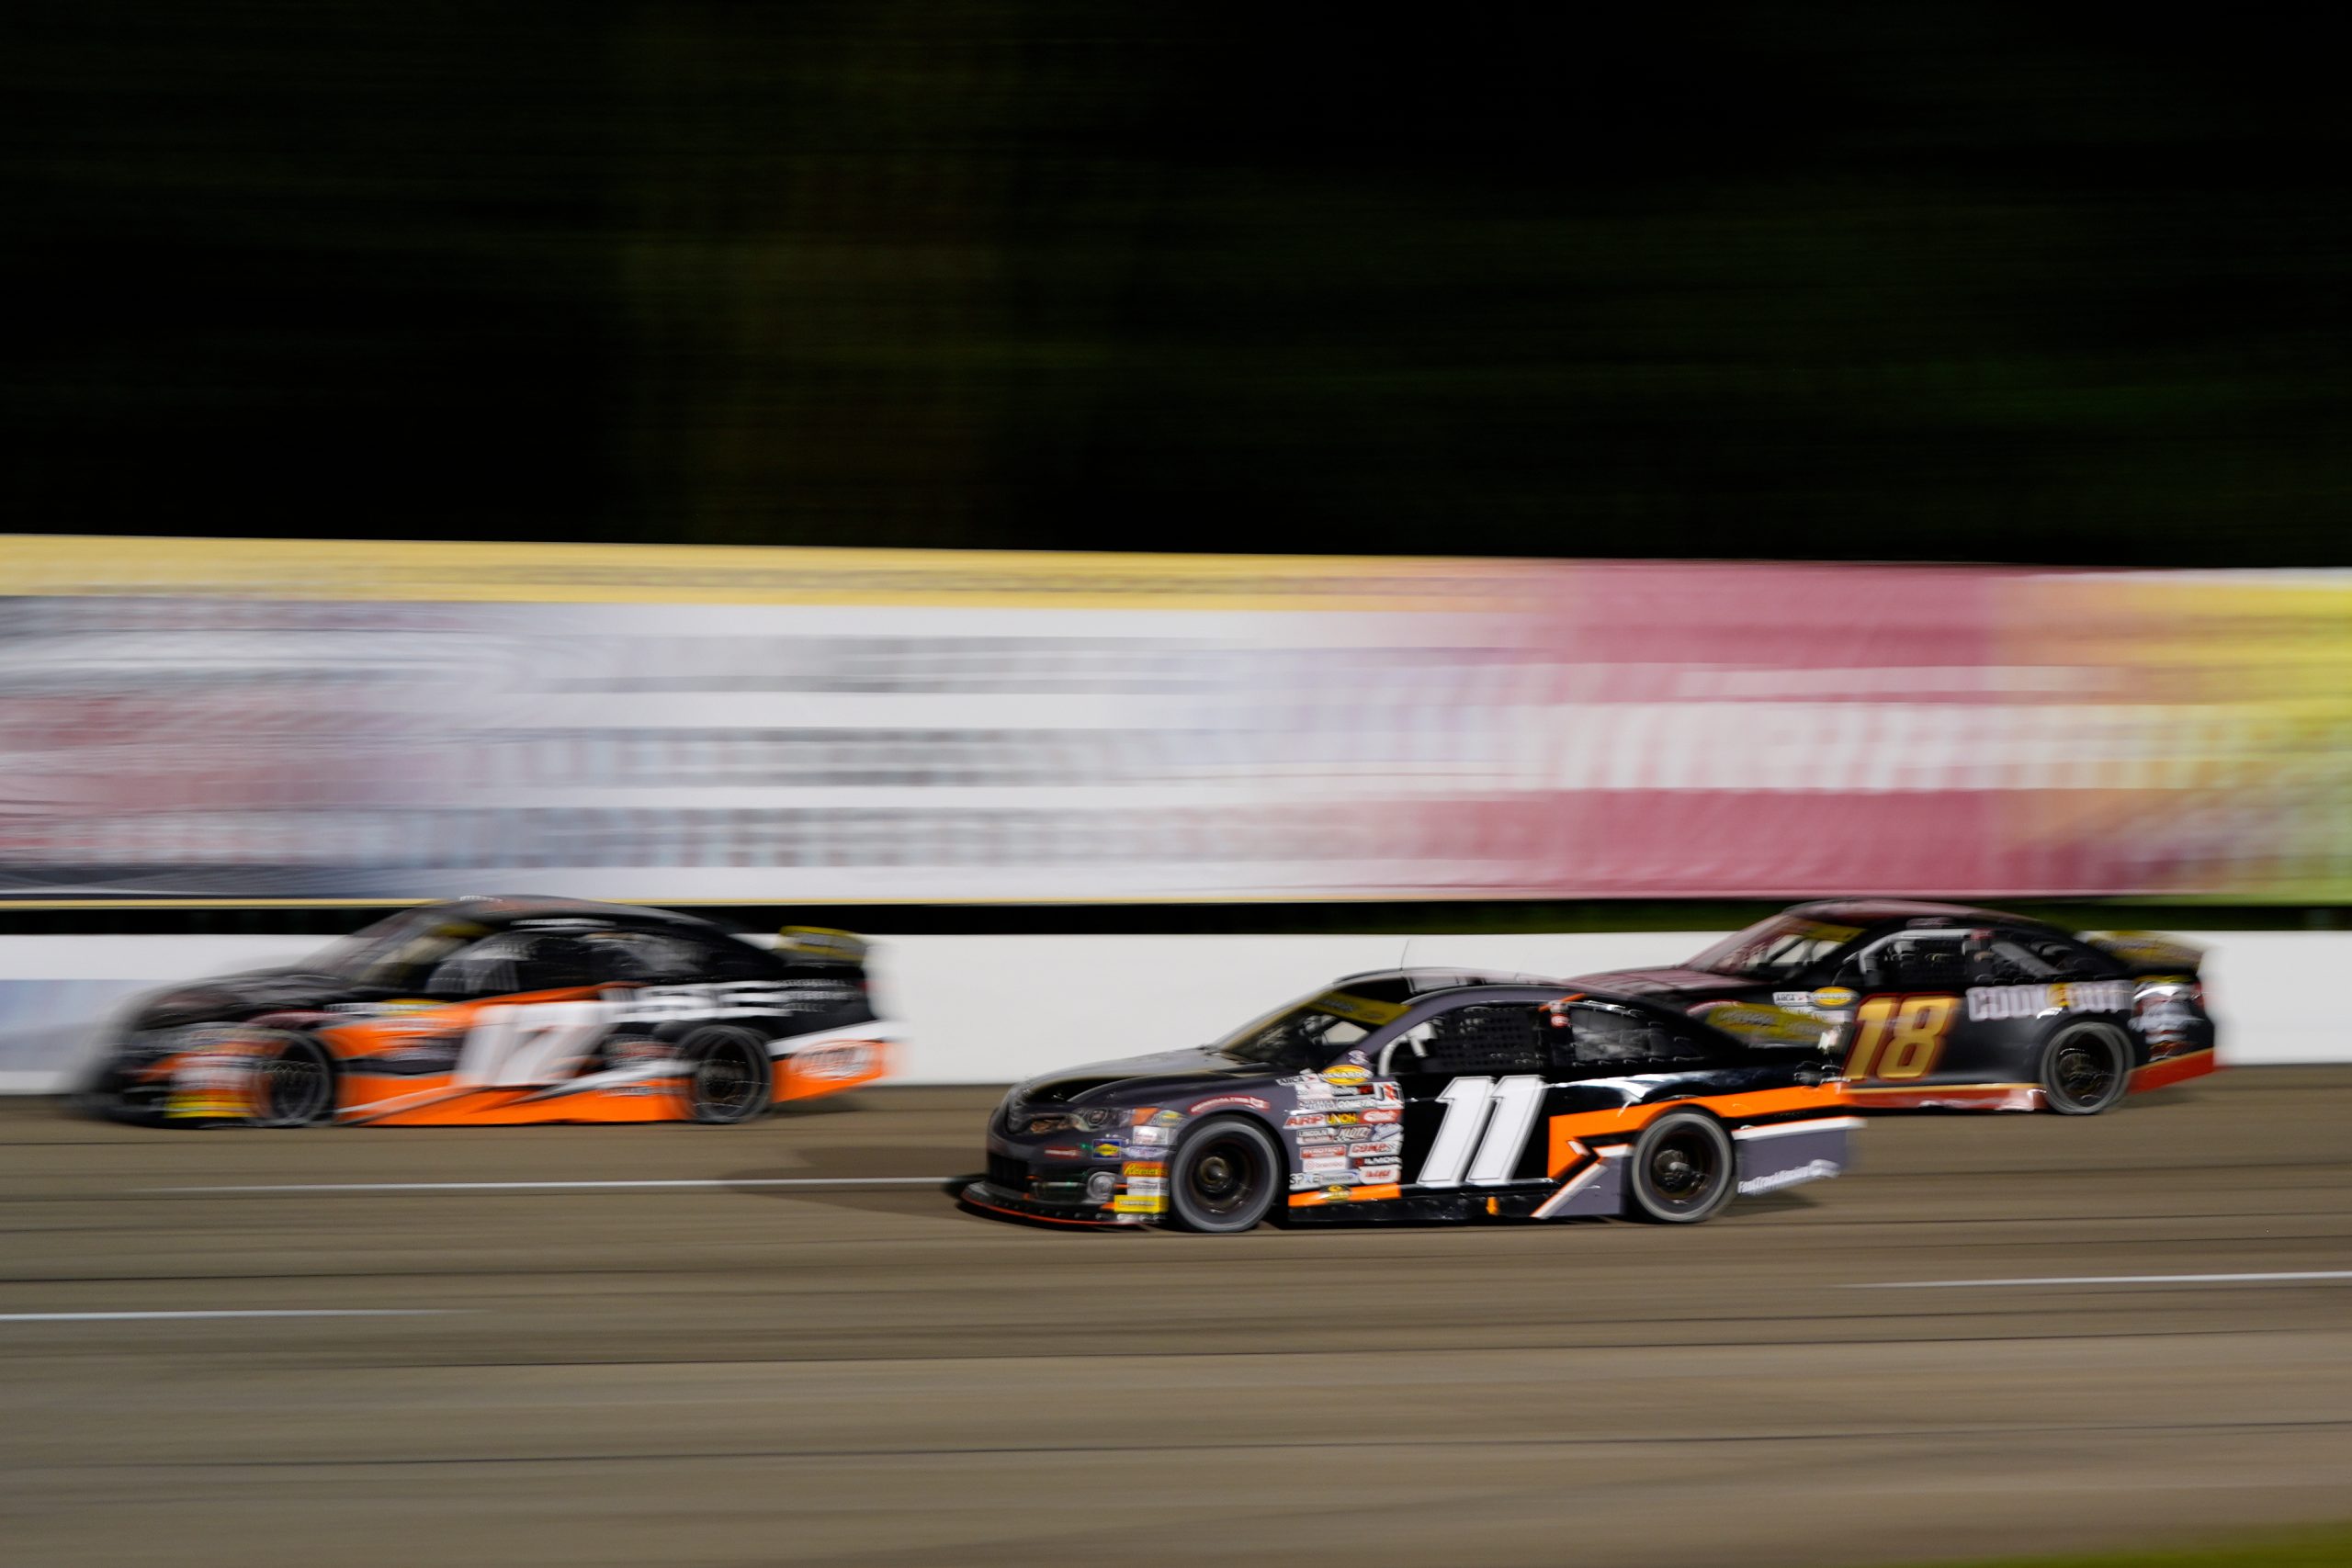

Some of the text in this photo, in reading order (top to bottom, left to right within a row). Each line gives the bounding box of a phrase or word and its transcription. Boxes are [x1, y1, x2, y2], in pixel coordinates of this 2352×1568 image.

[458, 1003, 621, 1086] 17
[1841, 994, 1957, 1080] 18
[1286, 1114, 1324, 1126] ARP
[1416, 1075, 1547, 1189] 11
